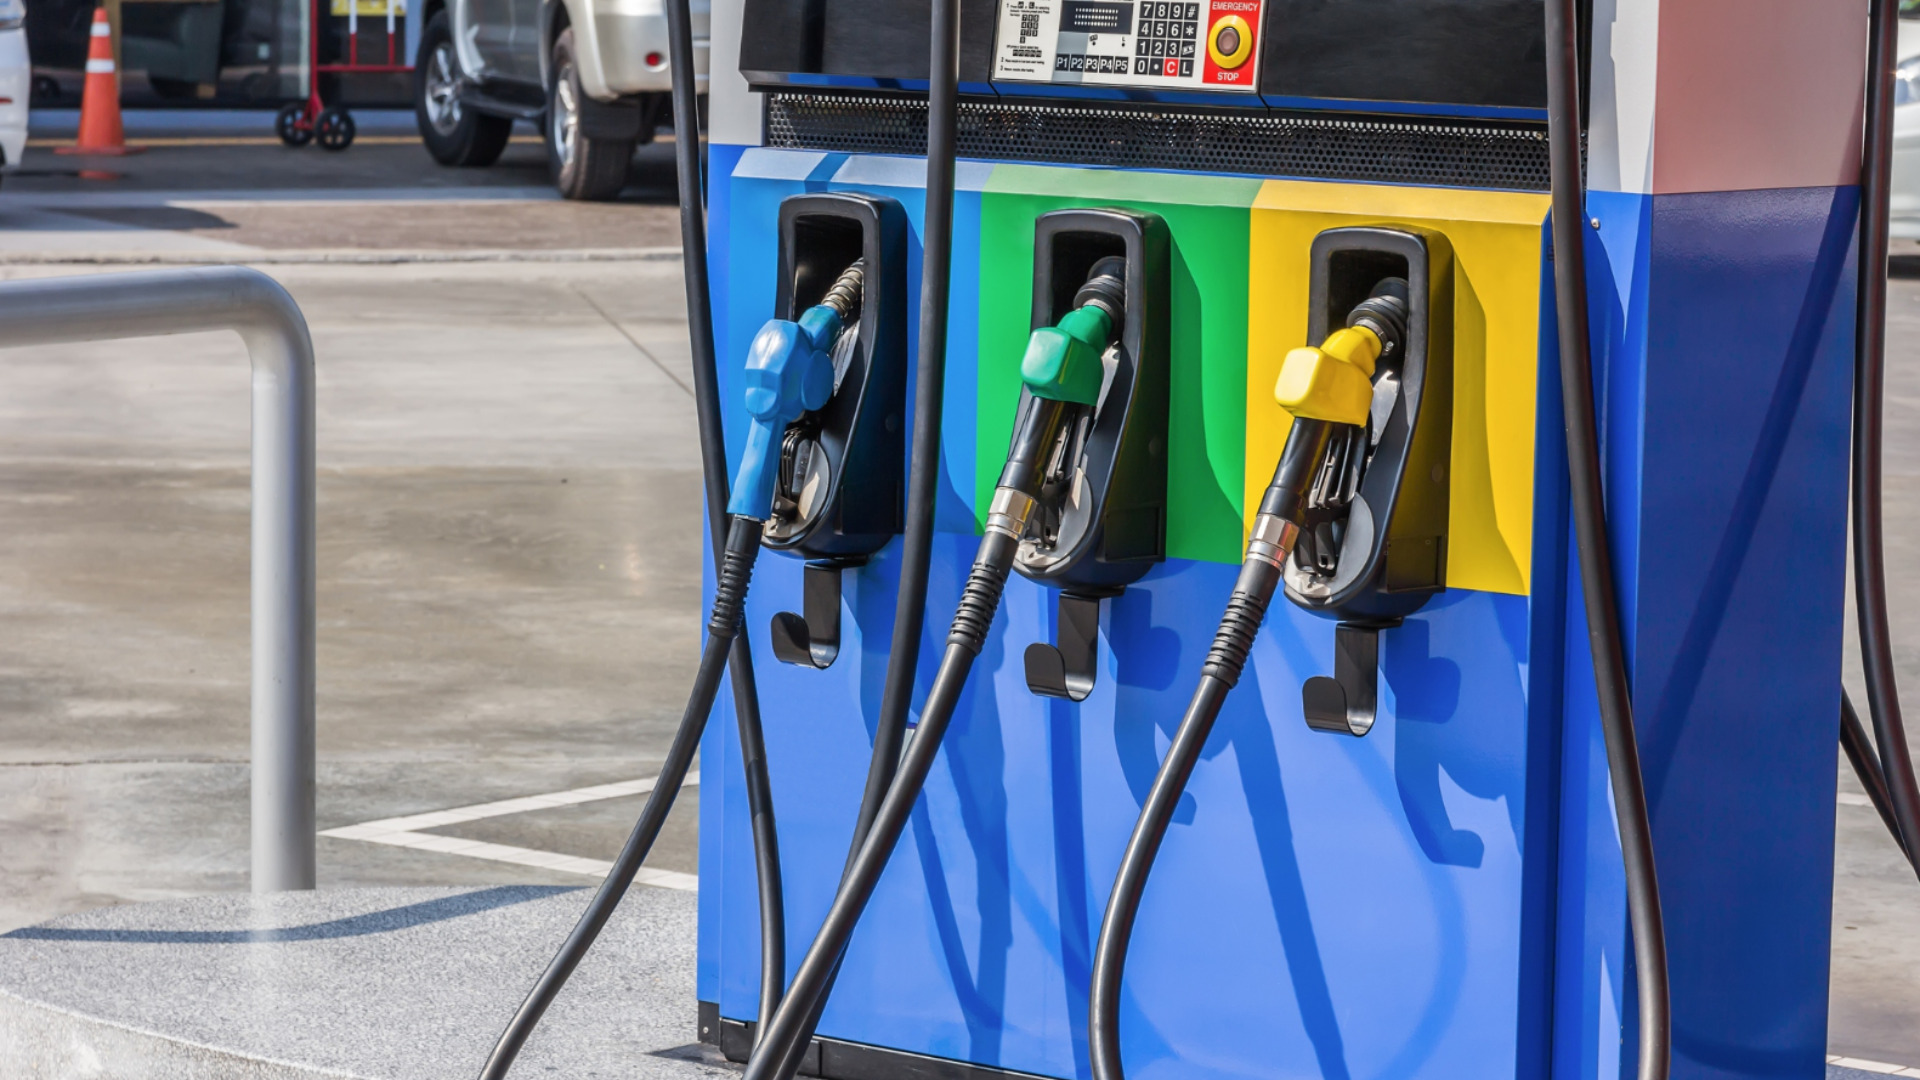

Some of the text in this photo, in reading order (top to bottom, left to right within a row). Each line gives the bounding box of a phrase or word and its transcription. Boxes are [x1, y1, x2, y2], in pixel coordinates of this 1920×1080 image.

[1143, 3, 1152, 17] 7
[1157, 4, 1166, 17] 8
[1172, 4, 1181, 18] 9
[1212, 1, 1258, 11] EMERGENCY
[1141, 22, 1179, 37] 4 5 6
[1140, 41, 1177, 55] 1 2 3
[1056, 57, 1068, 68] P1
[1070, 57, 1083, 69] P2
[1085, 58, 1098, 70] P3
[1100, 59, 1112, 70] P4
[1114, 59, 1128, 71] P5
[1137, 60, 1146, 73] 0
[1166, 60, 1176, 74] C
[1182, 61, 1190, 75] L
[1217, 72, 1239, 81] STOP
